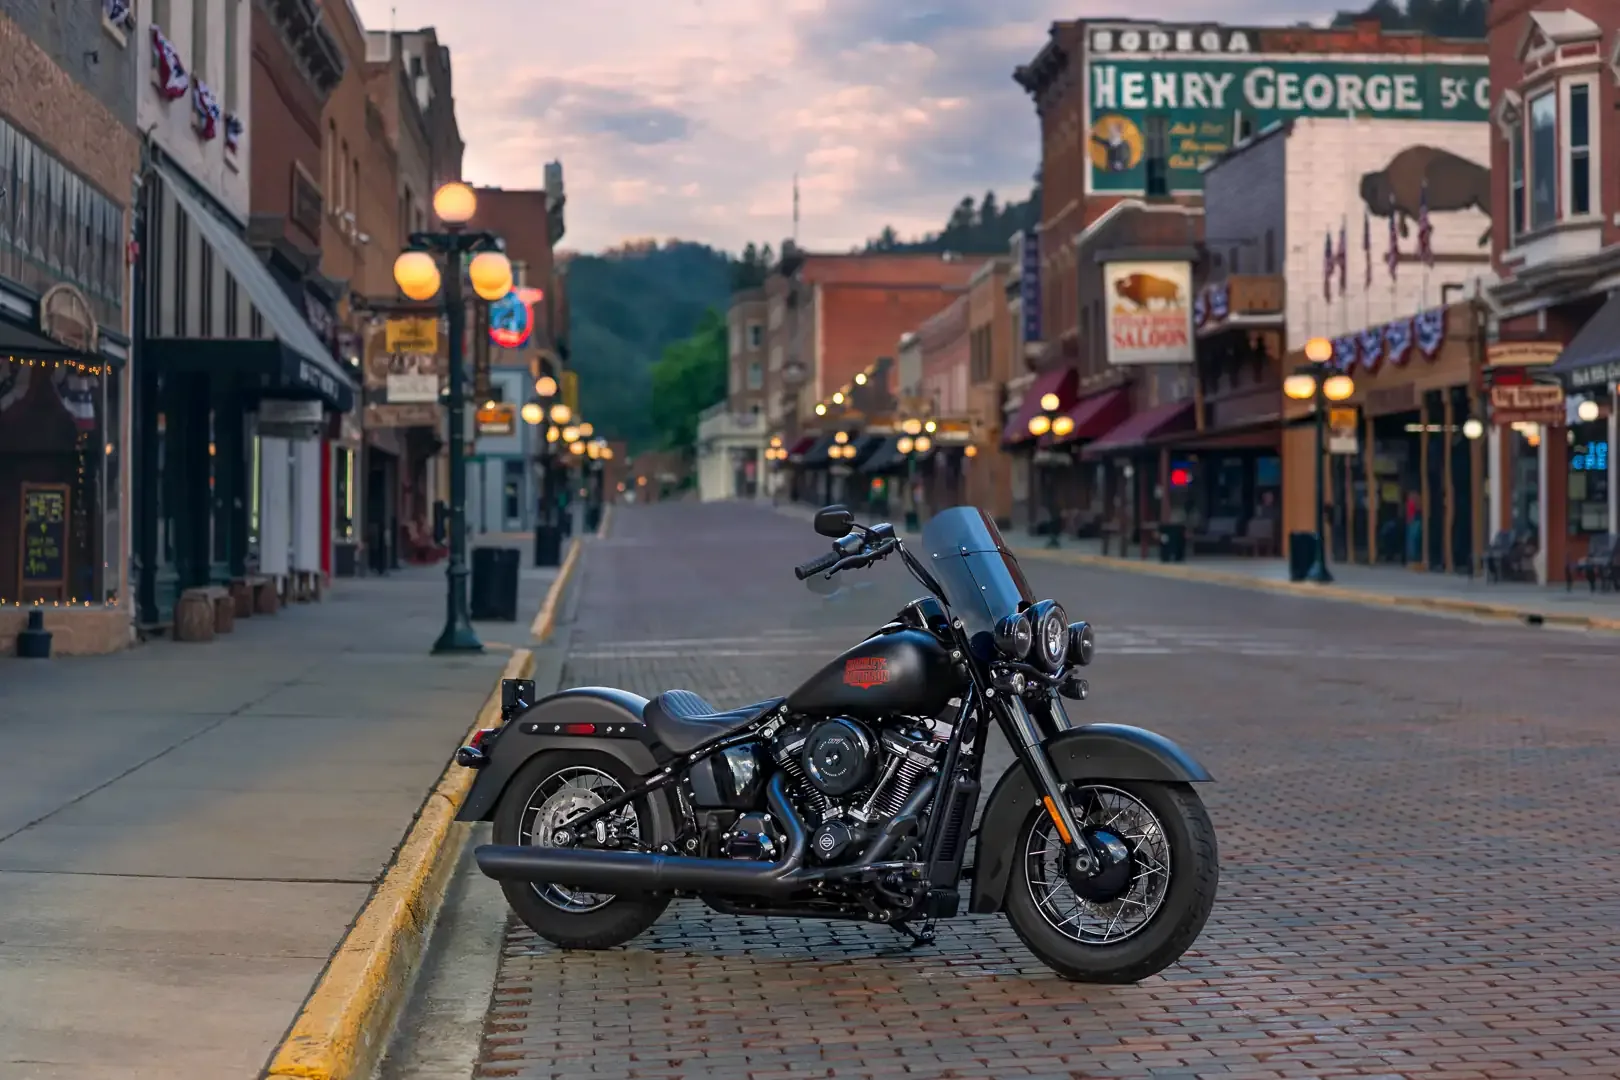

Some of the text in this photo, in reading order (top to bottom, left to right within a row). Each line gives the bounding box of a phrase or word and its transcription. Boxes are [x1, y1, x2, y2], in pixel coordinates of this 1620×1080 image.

[1093, 65, 1235, 109] HENRY
[1243, 67, 1424, 110] GEORGE
[1114, 330, 1188, 349] SALOON
